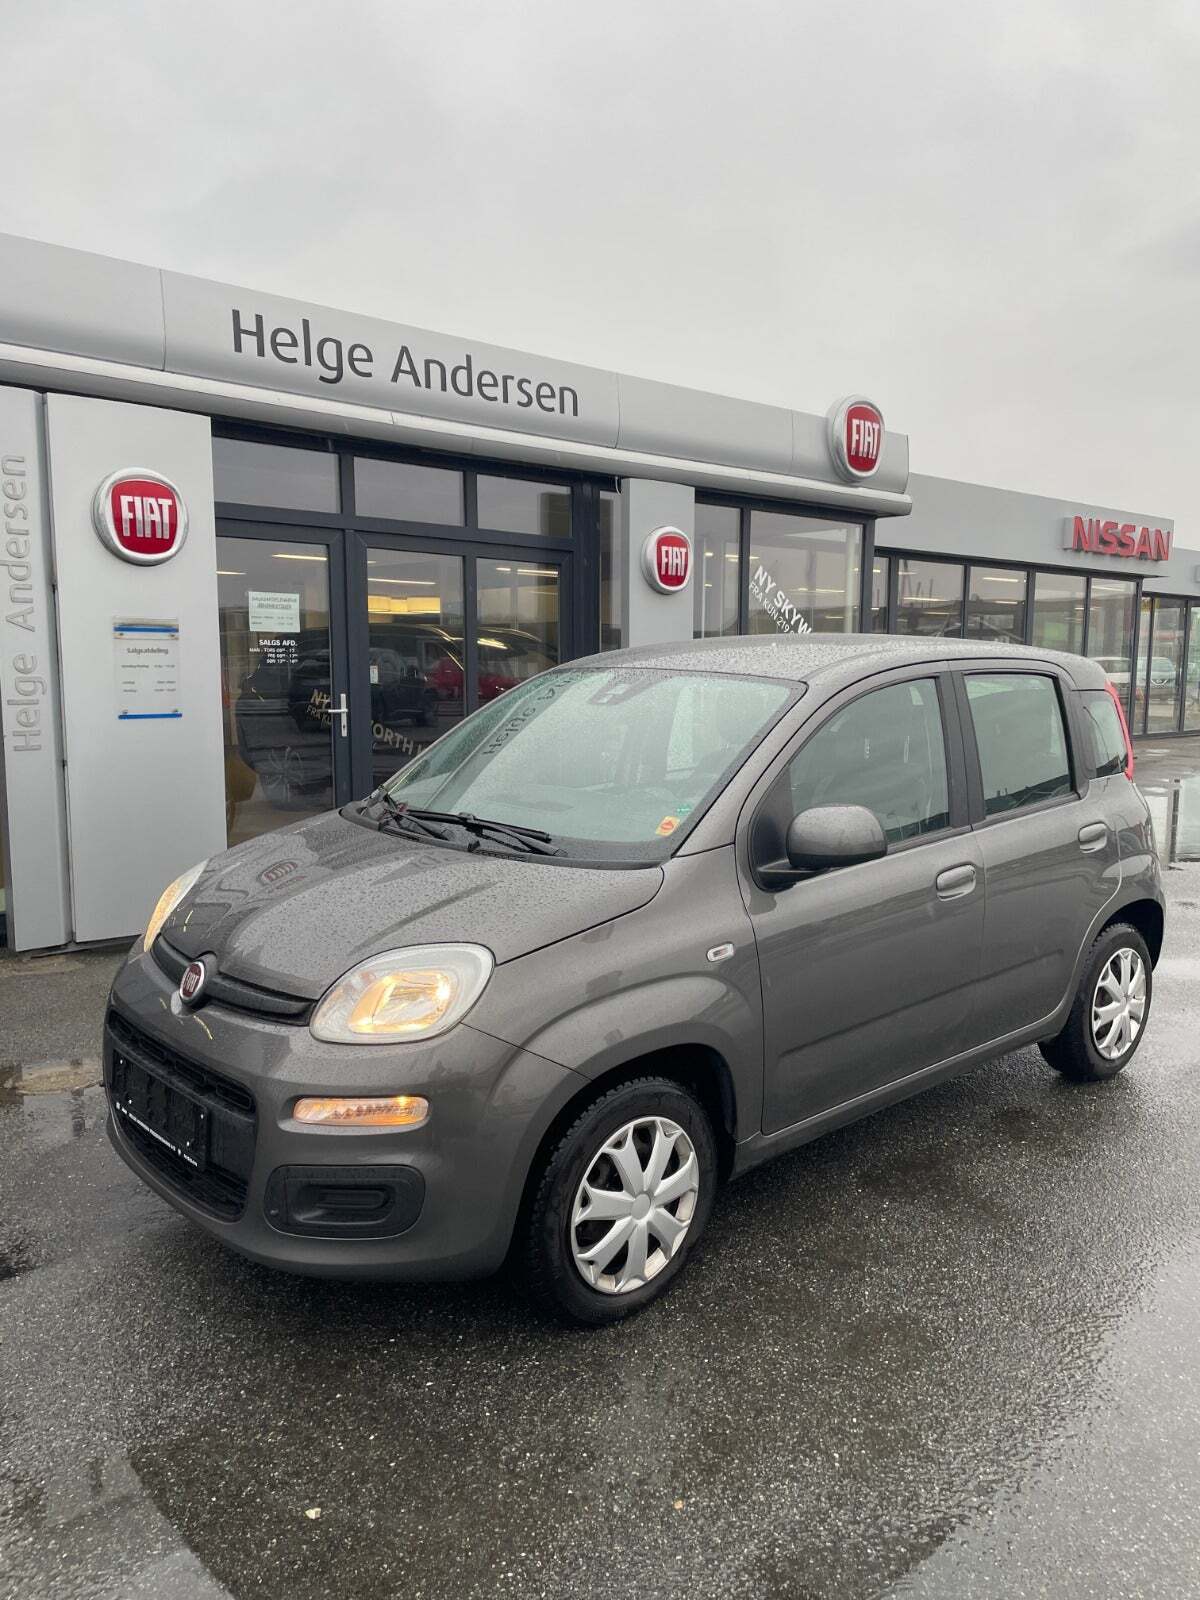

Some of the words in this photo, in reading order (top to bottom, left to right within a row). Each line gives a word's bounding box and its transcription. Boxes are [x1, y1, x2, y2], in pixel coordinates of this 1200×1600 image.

[231, 309, 374, 384] Helge
[391, 345, 579, 417] Andersen
[850, 418, 880, 459] FIAT
[120, 495, 173, 539] FIAT
[1071, 514, 1171, 561] NISSAN
[0, 454, 36, 632] Andersen
[661, 546, 688, 577] FIAT
[755, 565, 777, 593] NY
[749, 581, 763, 602] FRA
[763, 598, 779, 620] KUN
[259, 639, 281, 647] SALGS
[281, 639, 298, 647] AFD.
[7, 653, 47, 752] Helge
[370, 720, 415, 755] ORTH
